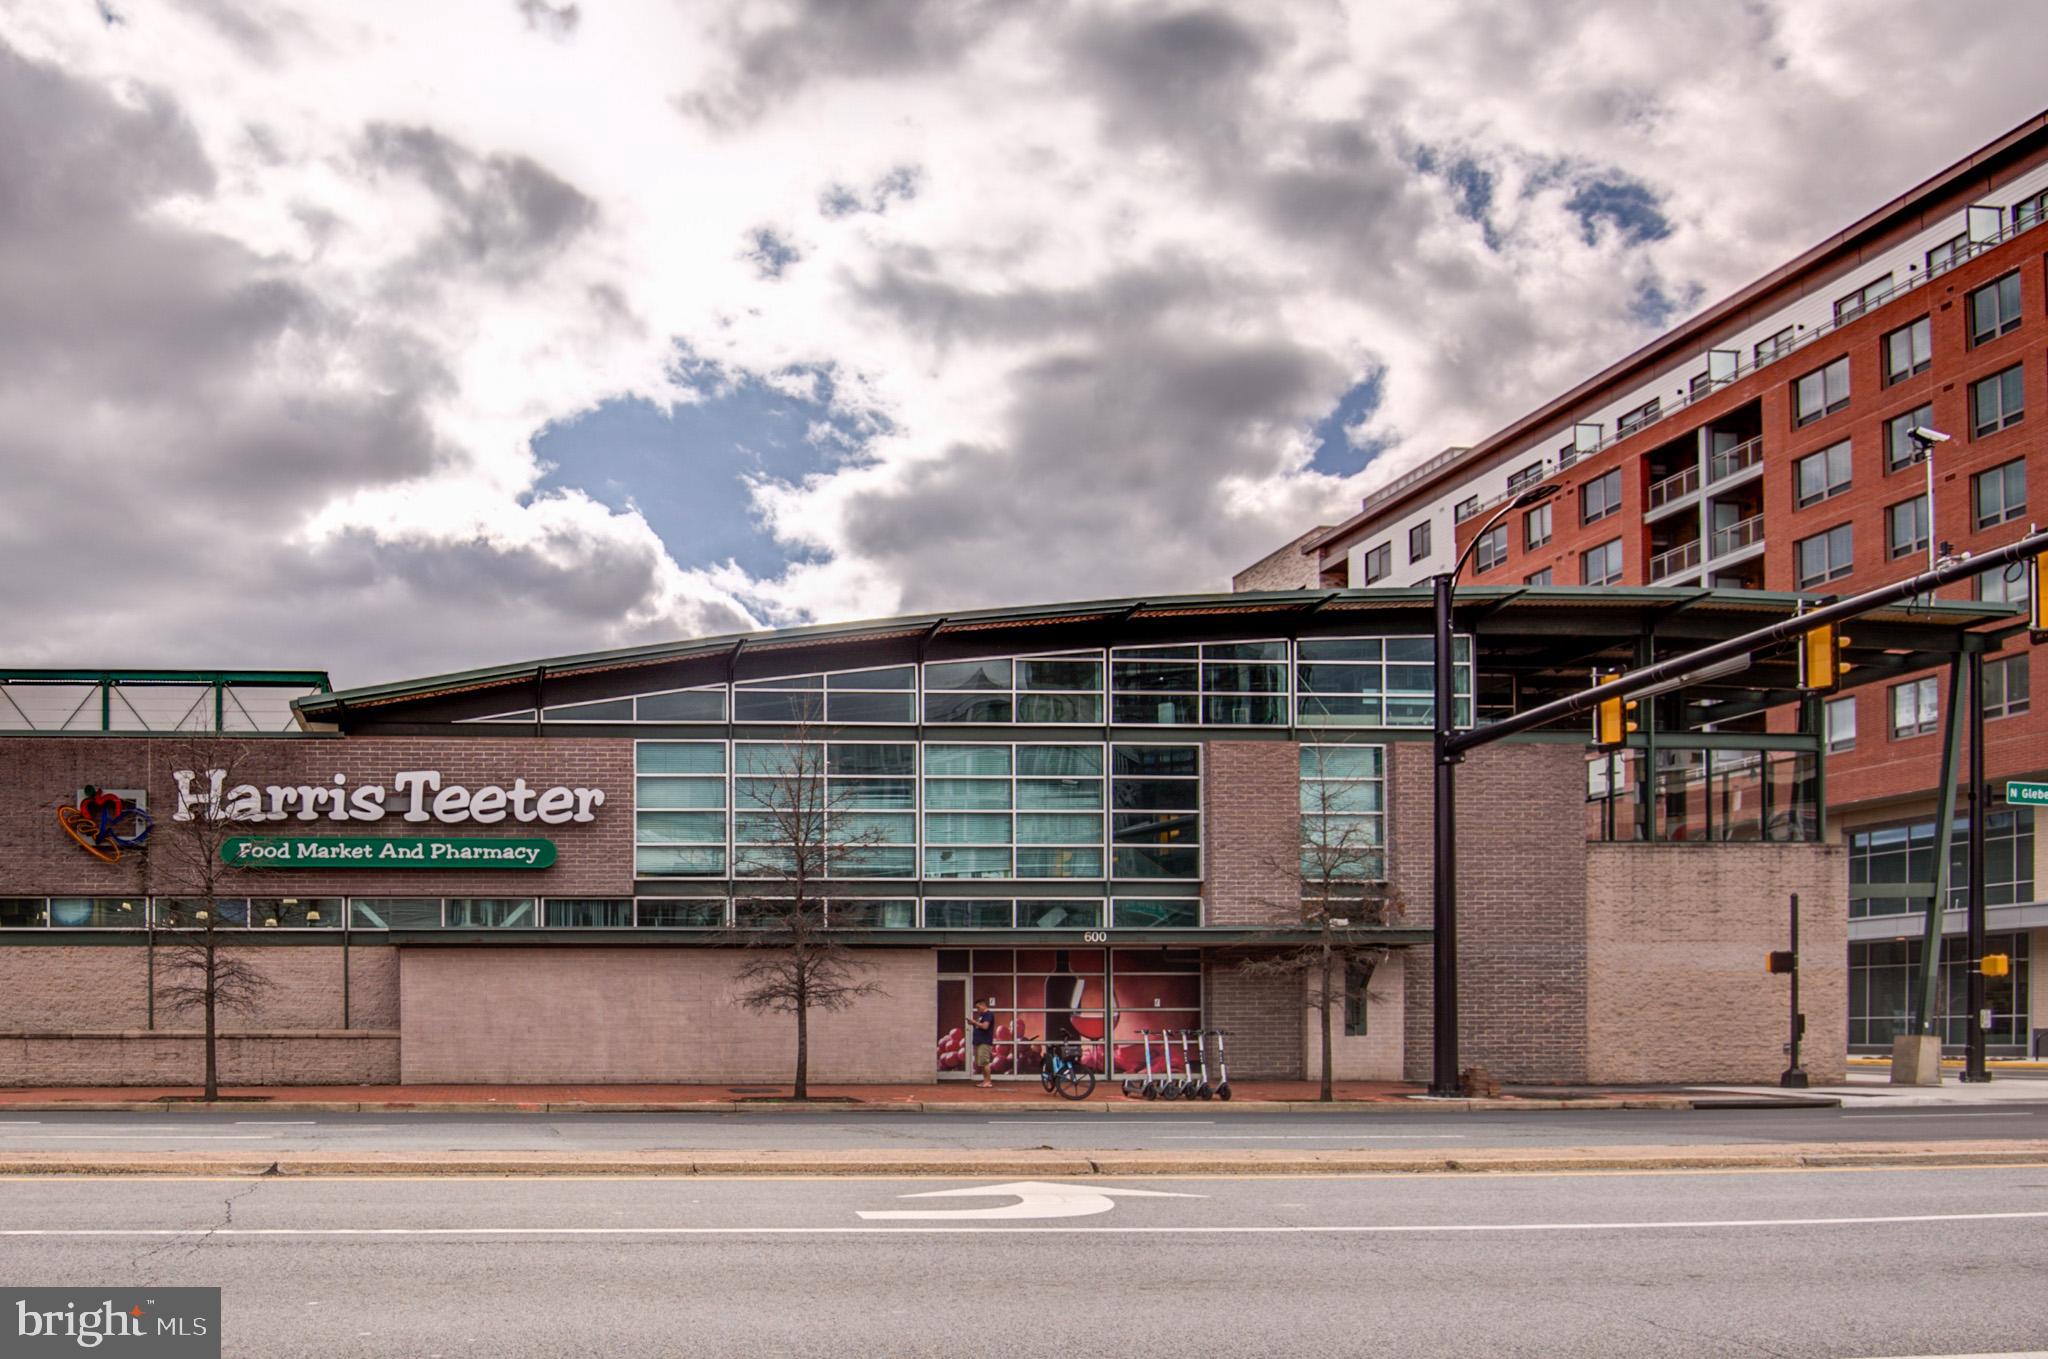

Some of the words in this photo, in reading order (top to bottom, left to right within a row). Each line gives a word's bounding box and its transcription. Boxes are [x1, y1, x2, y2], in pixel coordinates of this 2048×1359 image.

[172, 768, 386, 823] Harris
[394, 770, 606, 825] Teeter
[2010, 787, 2018, 798] N
[238, 842, 291, 859] Food
[296, 842, 374, 859] Market
[378, 842, 425, 860] And
[430, 842, 541, 864] Pharmacy
[1083, 931, 1107, 942] 600
